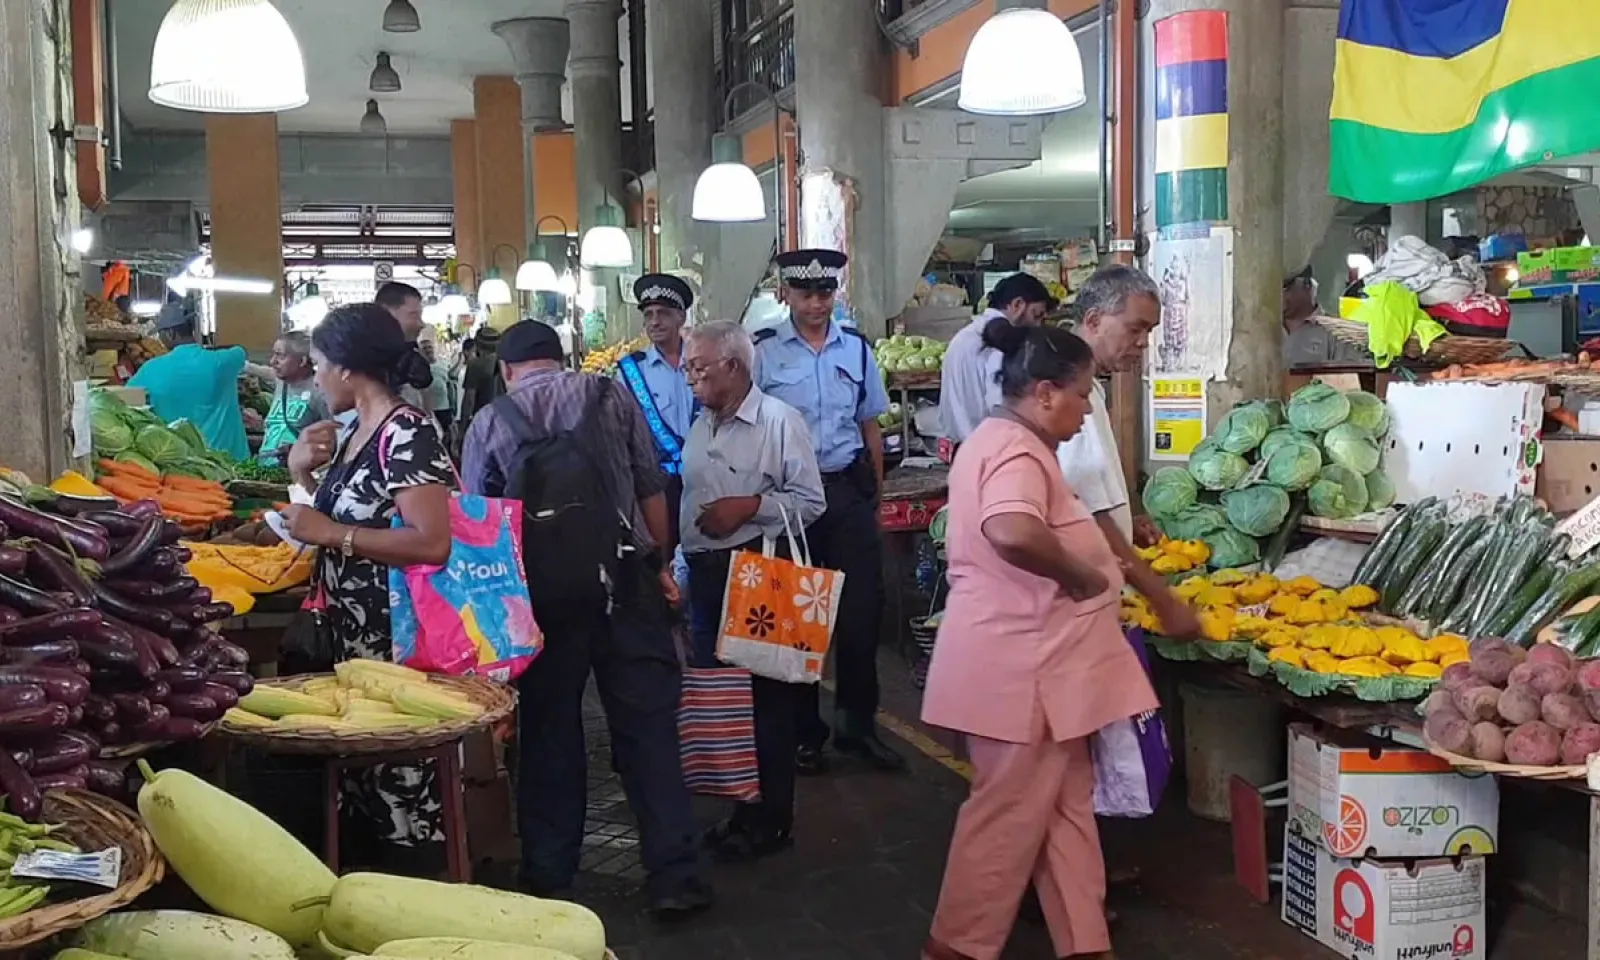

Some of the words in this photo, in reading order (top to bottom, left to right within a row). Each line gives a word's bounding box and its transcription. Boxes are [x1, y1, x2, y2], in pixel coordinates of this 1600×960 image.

[1382, 805, 1459, 835] Laziza
[1333, 927, 1375, 956] unifrutti
[1396, 942, 1453, 960] unifrutti
